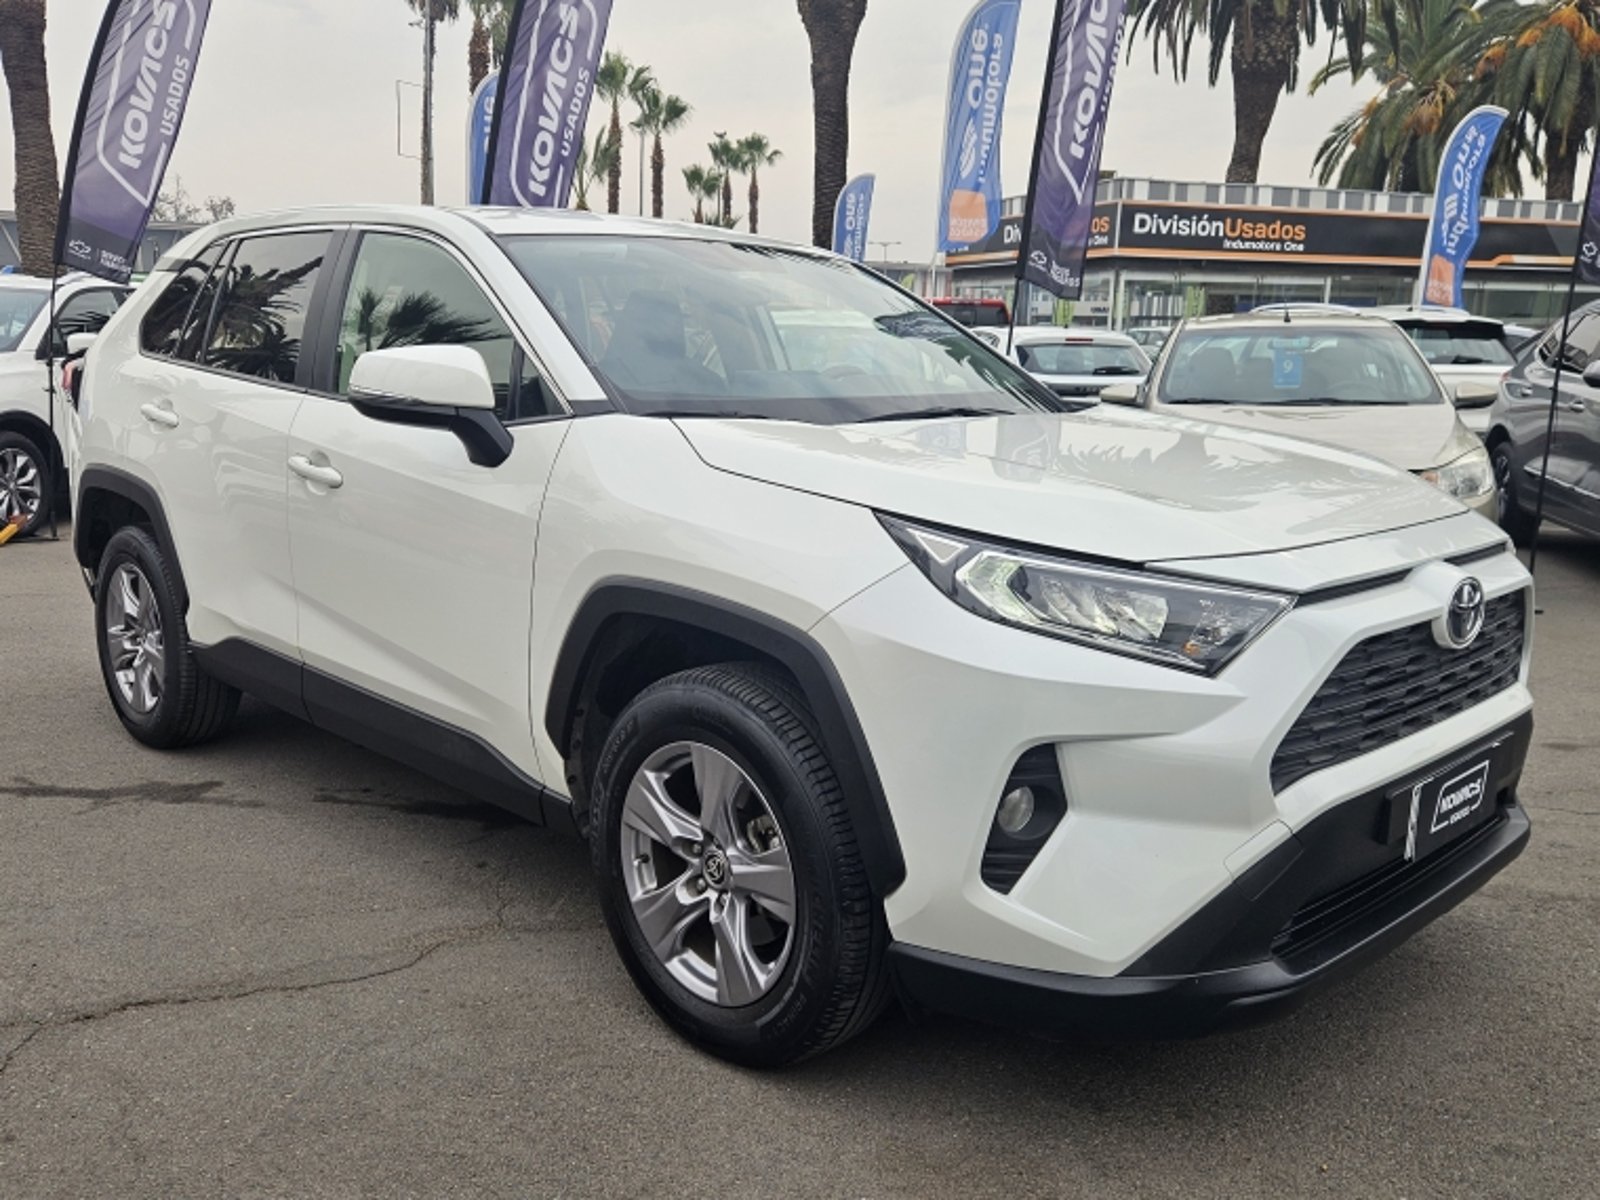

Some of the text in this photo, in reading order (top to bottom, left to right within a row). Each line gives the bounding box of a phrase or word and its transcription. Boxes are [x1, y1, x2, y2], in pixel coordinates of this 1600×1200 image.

[118, 0, 178, 169] KOVACS
[160, 55, 190, 136] USADOS
[528, 3, 579, 197] KOVACS
[561, 67, 590, 157] USADOS
[1069, 0, 1108, 160] KOVAC
